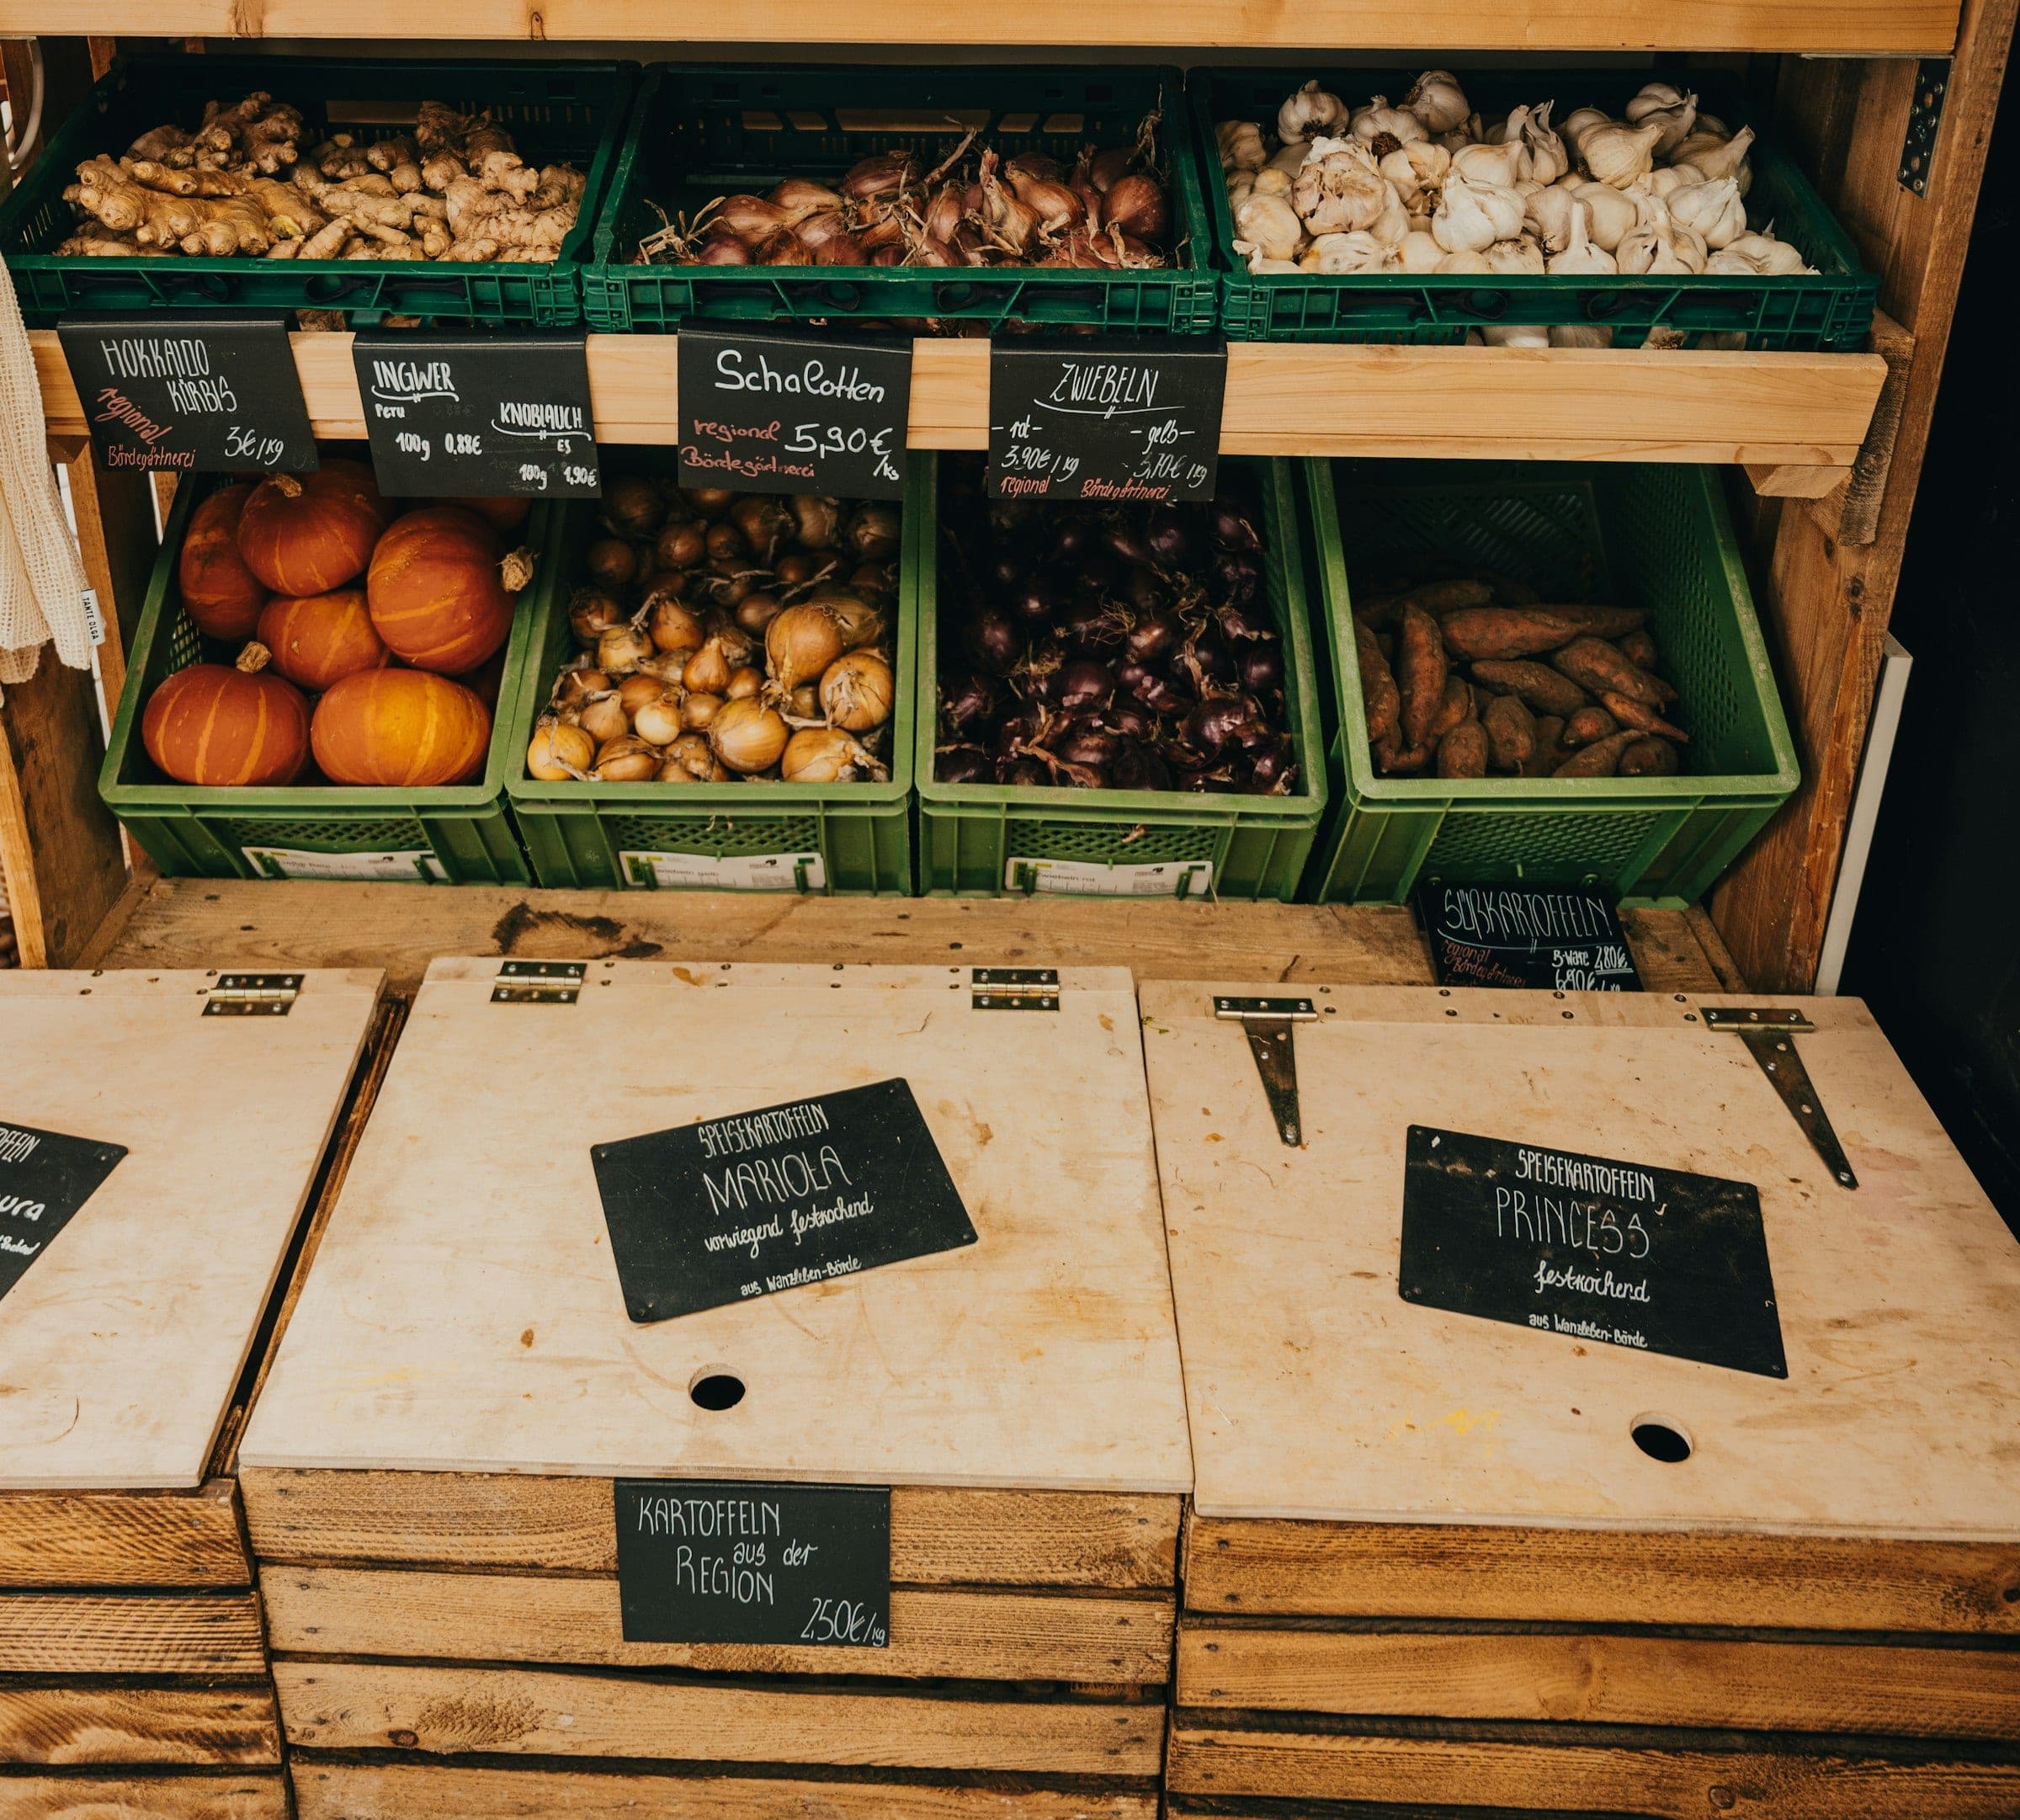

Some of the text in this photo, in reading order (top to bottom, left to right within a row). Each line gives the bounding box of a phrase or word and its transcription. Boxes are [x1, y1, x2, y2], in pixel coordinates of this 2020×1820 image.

[100, 338, 210, 379] HOKKAIDO
[373, 360, 455, 392] INGWER
[715, 349, 885, 403] Schalotten
[166, 375, 238, 416] KÜRBIS
[1049, 362, 1160, 407] ZWIEBELN
[93, 387, 173, 445] regional
[499, 402, 583, 430] KNOBLAUCH
[108, 444, 196, 471] Bördegärtnerei
[395, 432, 431, 462] 100g
[694, 419, 894, 460] regional 5,90€
[518, 463, 547, 492] 100g
[1000, 474, 1051, 500] regional
[82, 598, 99, 640] TANTE OLGA
[698, 1104, 830, 1159] SPEISEKARTOFFELN
[1515, 1148, 1656, 1202] SPEISEKARTOFFELN
[704, 1190, 874, 1259] vorwiegend festkochend
[1496, 1187, 1651, 1259] PRINCESS
[740, 1280, 763, 1297] aus
[1534, 1259, 1651, 1303] festkochend
[1528, 1313, 1550, 1330] aus
[637, 1496, 780, 1536] KARTOFFELN
[733, 1538, 818, 1566] aus der
[676, 1545, 773, 1605] REGION
